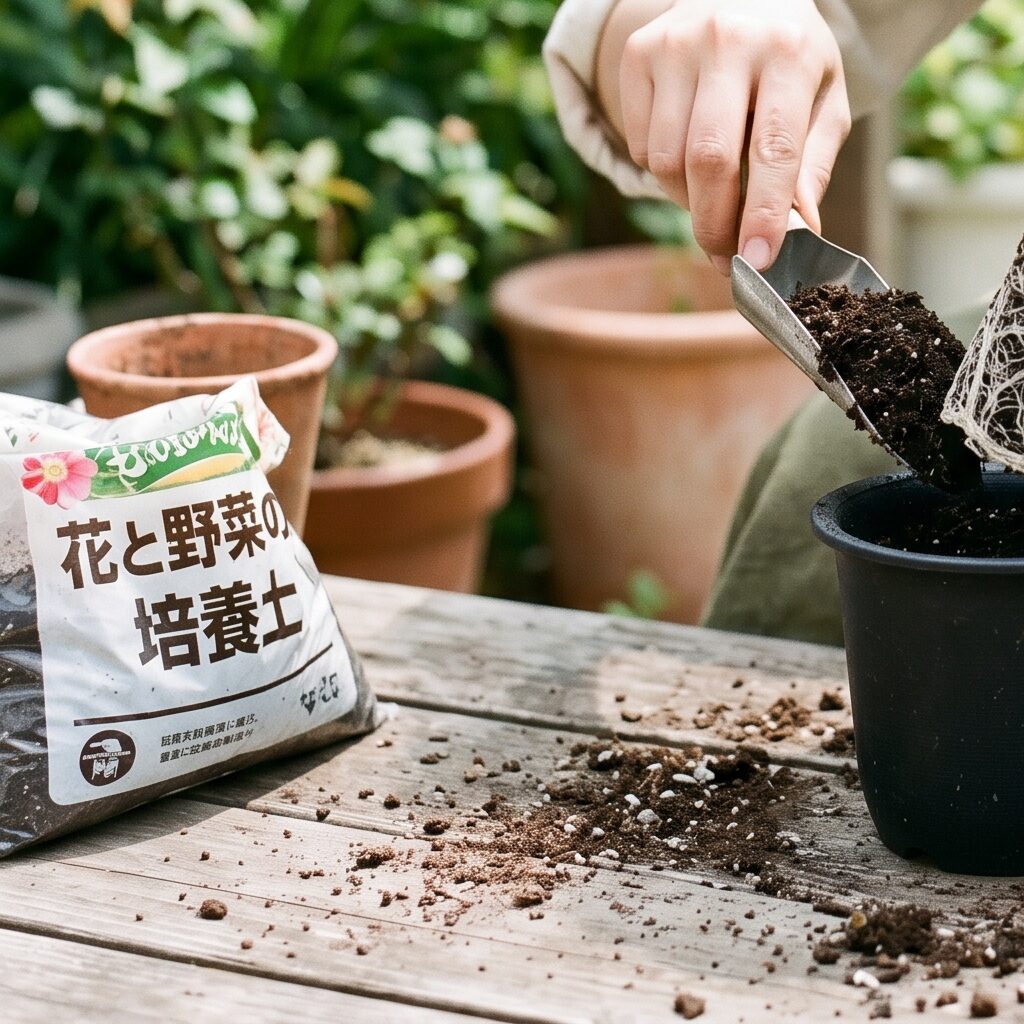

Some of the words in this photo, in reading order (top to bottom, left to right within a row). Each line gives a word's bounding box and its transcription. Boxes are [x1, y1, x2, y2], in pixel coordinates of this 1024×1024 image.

[57, 491, 289, 589] 花と野菜の
[134, 569, 302, 670] 培養土
